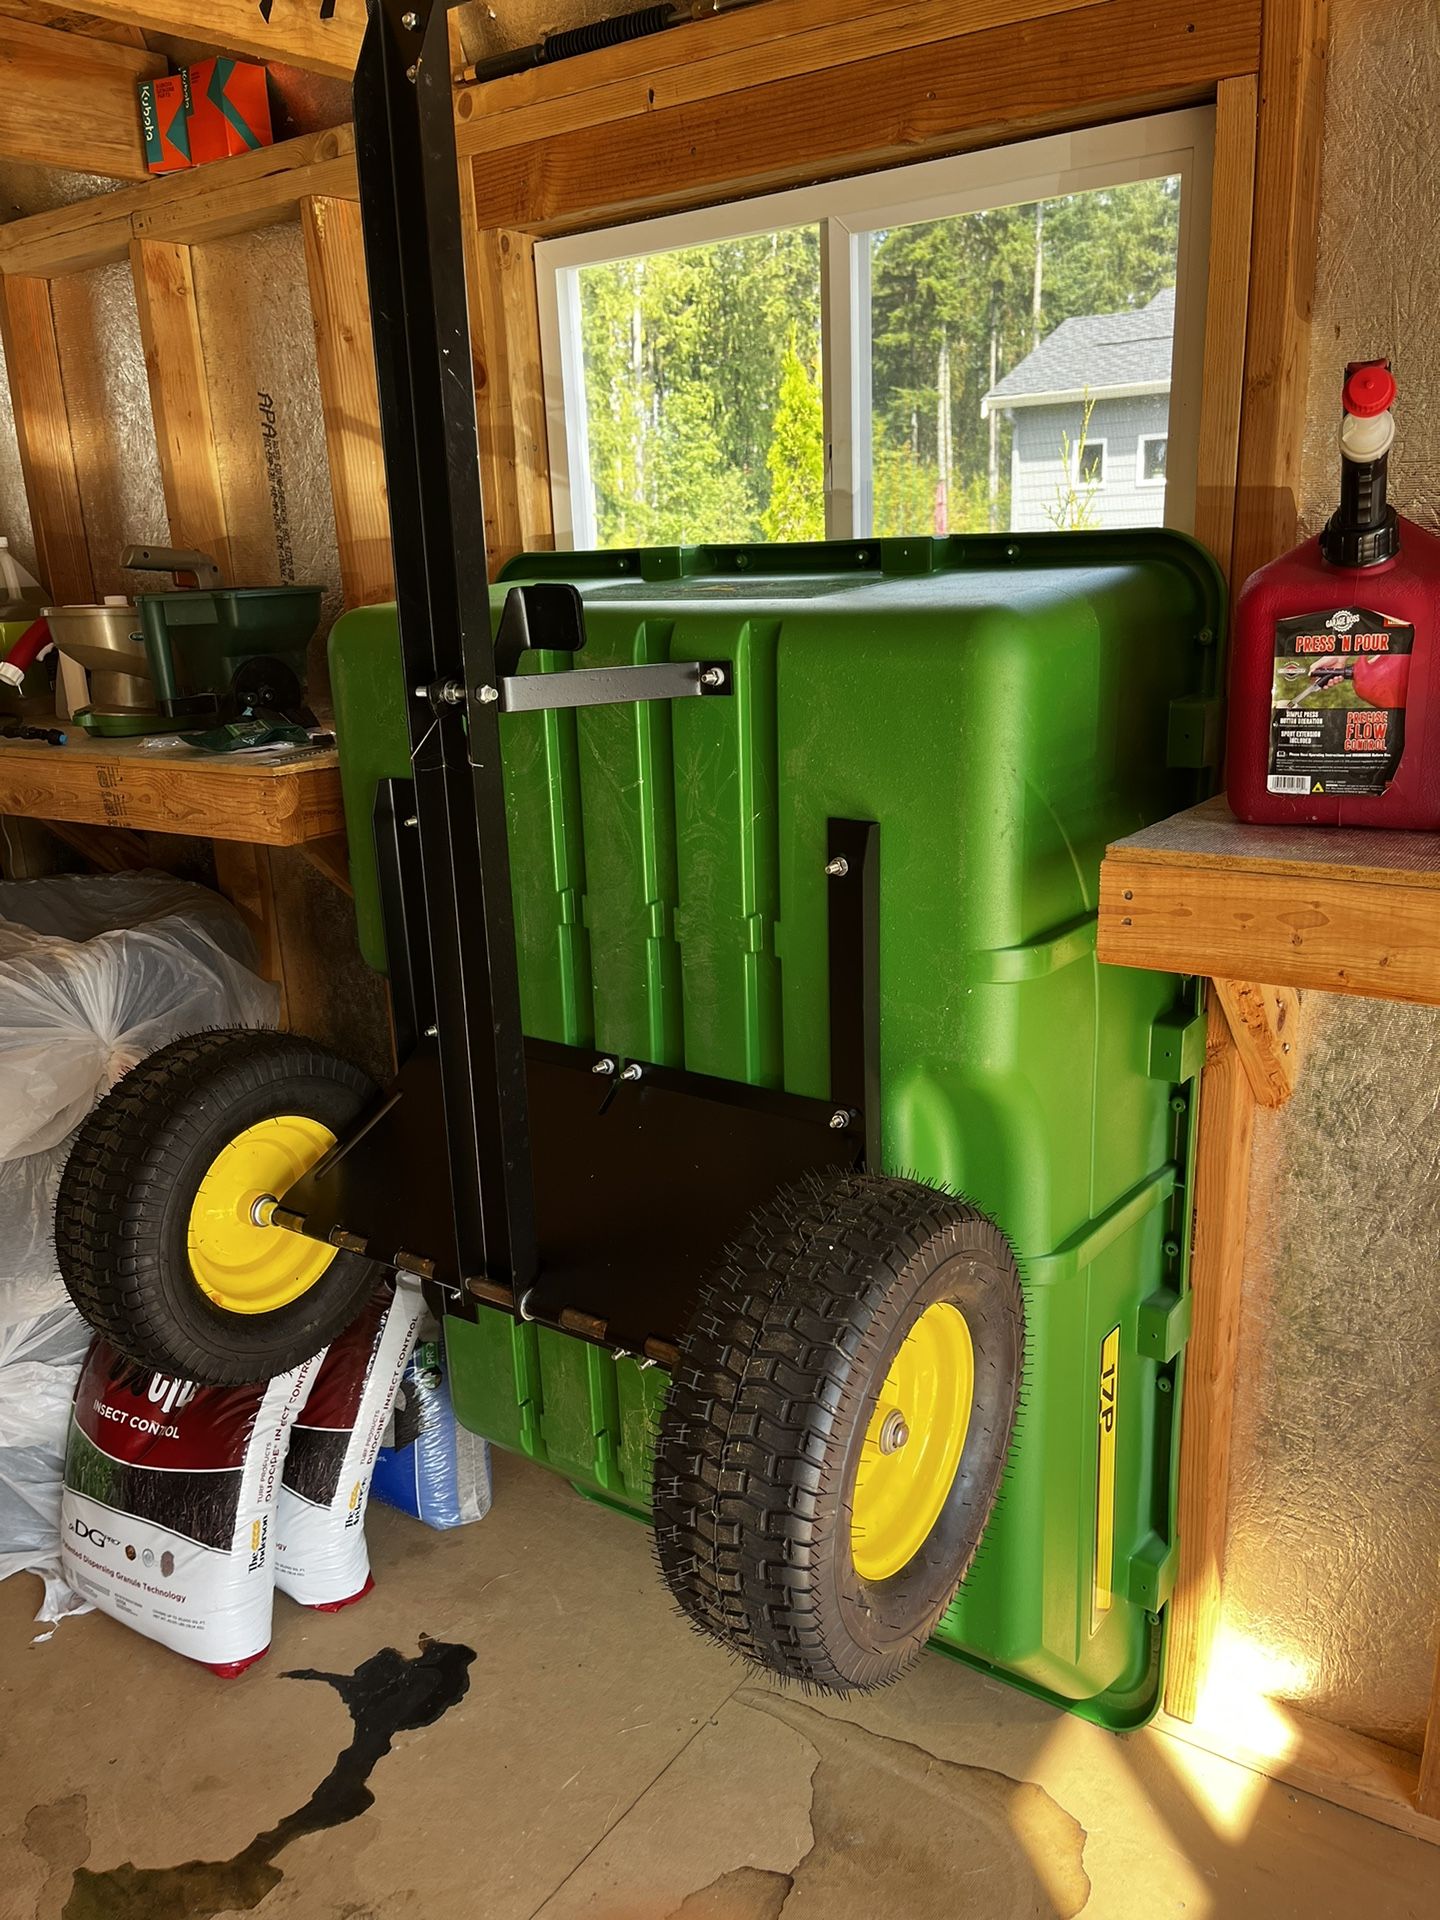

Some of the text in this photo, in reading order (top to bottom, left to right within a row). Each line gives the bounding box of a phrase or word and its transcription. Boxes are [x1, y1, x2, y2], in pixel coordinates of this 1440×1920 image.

[141, 86, 154, 141] Kubota
[258, 391, 277, 439] APA
[1295, 635, 1335, 653] PRESS
[1354, 633, 1390, 651] POUR
[1345, 723, 1388, 739] FLOW
[1346, 711, 1389, 724] PRECISE
[1344, 738, 1388, 751] CONTROL
[384, 1371, 399, 1410] INSECT
[397, 1316, 419, 1368] CONTROL
[93, 1399, 129, 1424] INSECT
[1102, 1363, 1115, 1433] 17P
[260, 1442, 272, 1480] PRODUCTS
[83, 1554, 115, 1578] Dispersing
[115, 1571, 141, 1589] Granule
[142, 1582, 187, 1604] Technology
